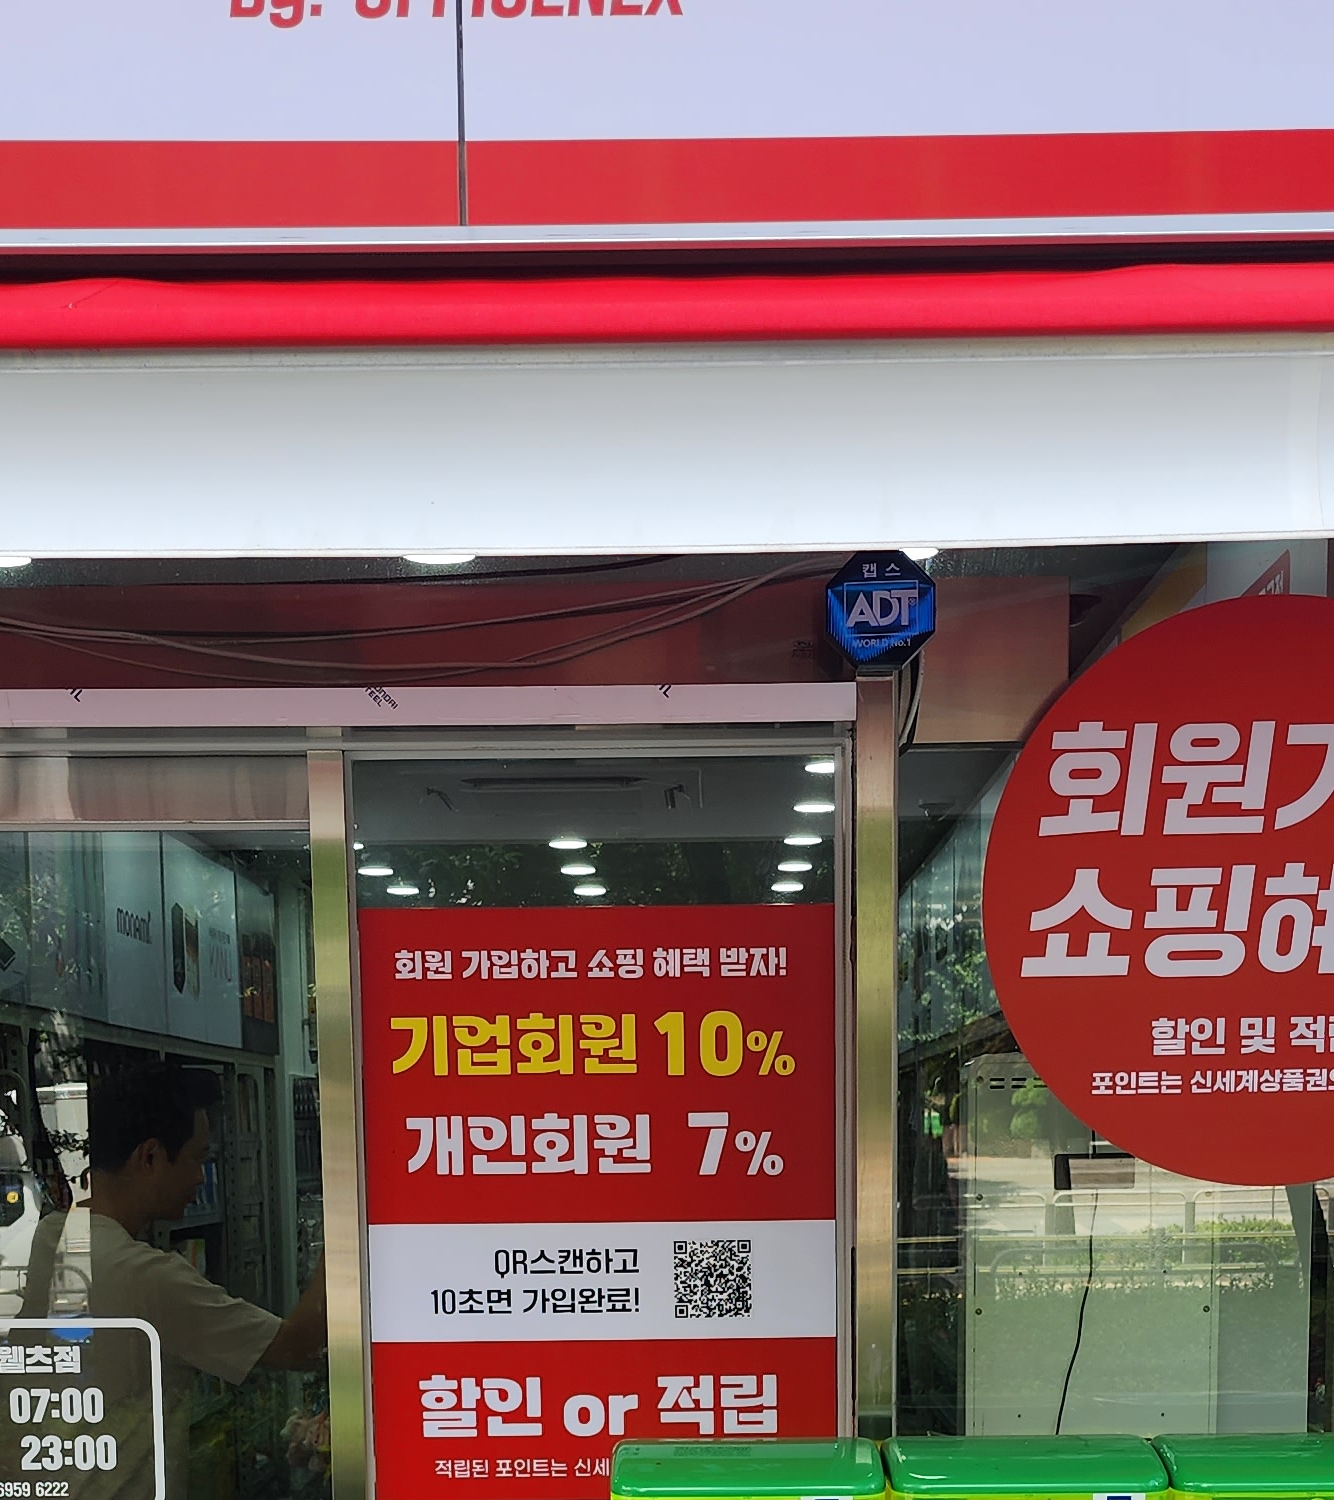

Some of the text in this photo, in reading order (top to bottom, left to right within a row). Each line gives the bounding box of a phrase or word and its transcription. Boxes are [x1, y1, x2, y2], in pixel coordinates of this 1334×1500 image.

[846, 590, 917, 627] ADT
[853, 639, 888, 647] WORLD
[395, 947, 787, 980] 회원 가입하고 쇼핑 혜택 받자!
[390, 1010, 795, 1076] 기업회원 10%
[1151, 1017, 1226, 1056] 할인
[1241, 1017, 1275, 1053] 및
[1091, 1069, 1182, 1096] 포인트는
[406, 1111, 784, 1176] 개인회원 7%
[494, 1248, 639, 1279] QR스캔하고
[431, 1287, 639, 1315] 10초면 가입완료!
[10, 1387, 103, 1423] 07:00
[418, 1375, 778, 1438] 할인 or 적립
[21, 1435, 116, 1471] 23:00
[435, 1459, 568, 1479] 적립된 포인트는
[36, 1482, 69, 1497] 6222
